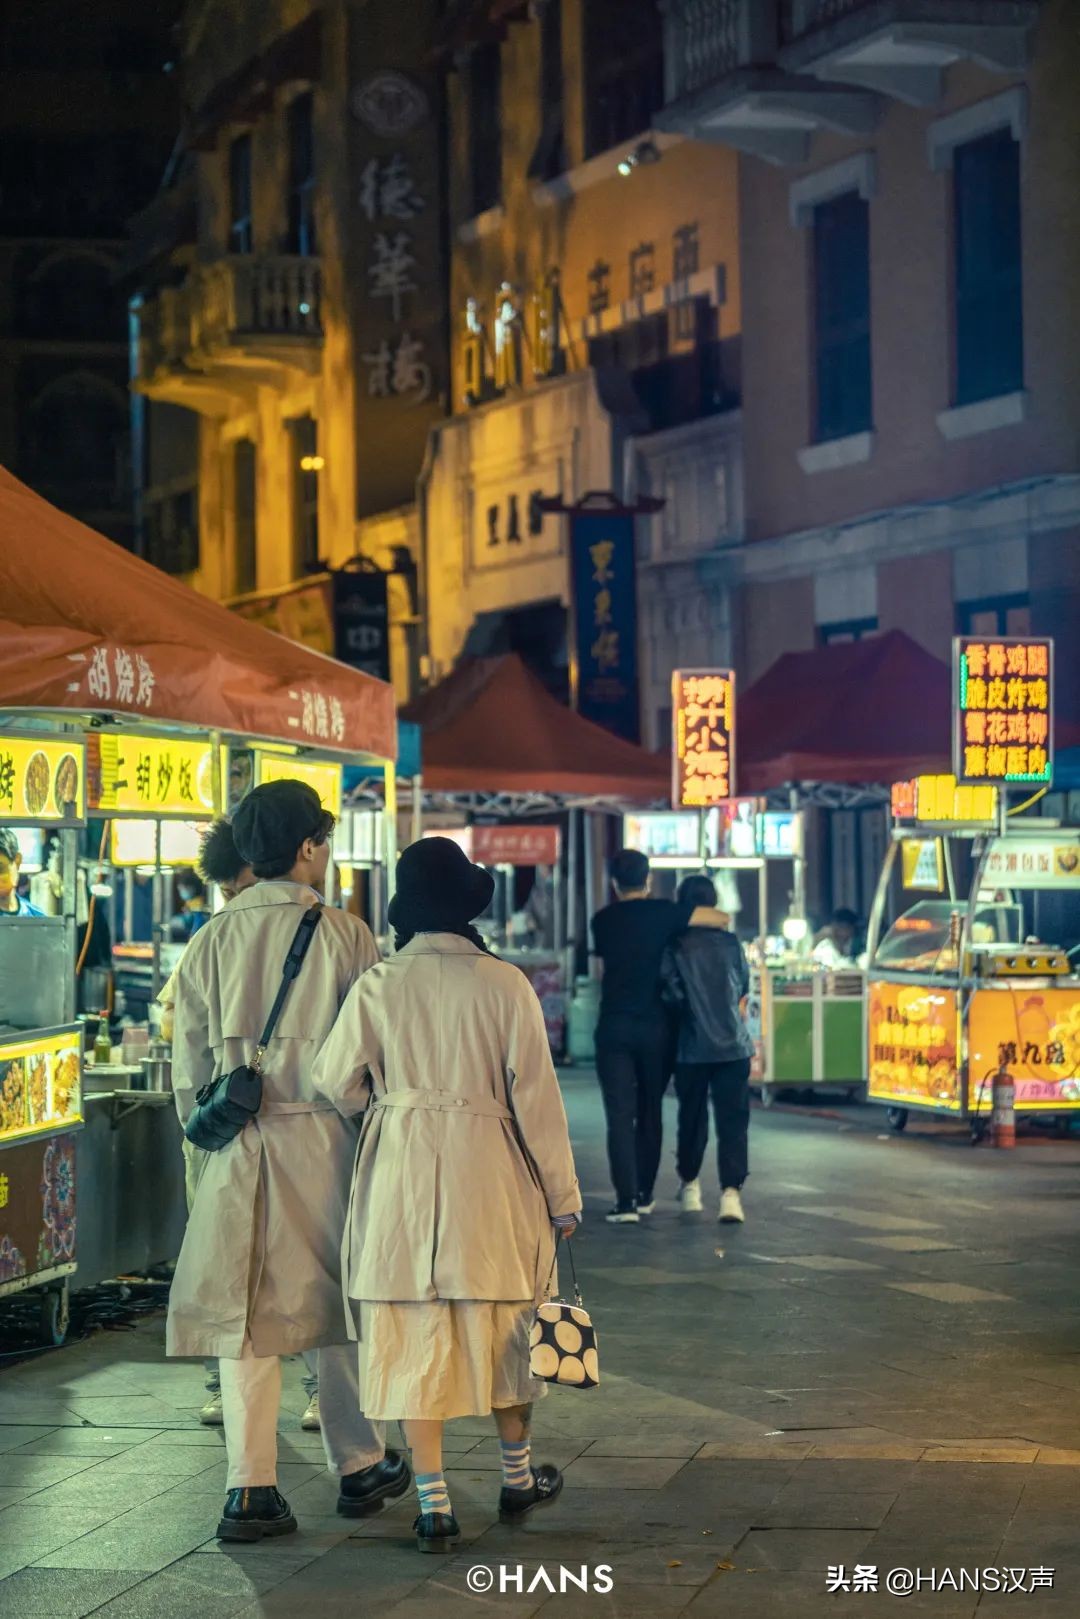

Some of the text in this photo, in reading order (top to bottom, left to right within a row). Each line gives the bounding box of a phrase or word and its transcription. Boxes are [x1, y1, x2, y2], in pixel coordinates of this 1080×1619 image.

[66, 646, 155, 708] 二胡烧烤
[966, 677, 1048, 710] 脆皮炸鸡
[287, 688, 346, 742] 二胡烧烤
[965, 711, 1048, 744] 雪花鸡柳
[112, 752, 194, 802] 二胡炒饭
